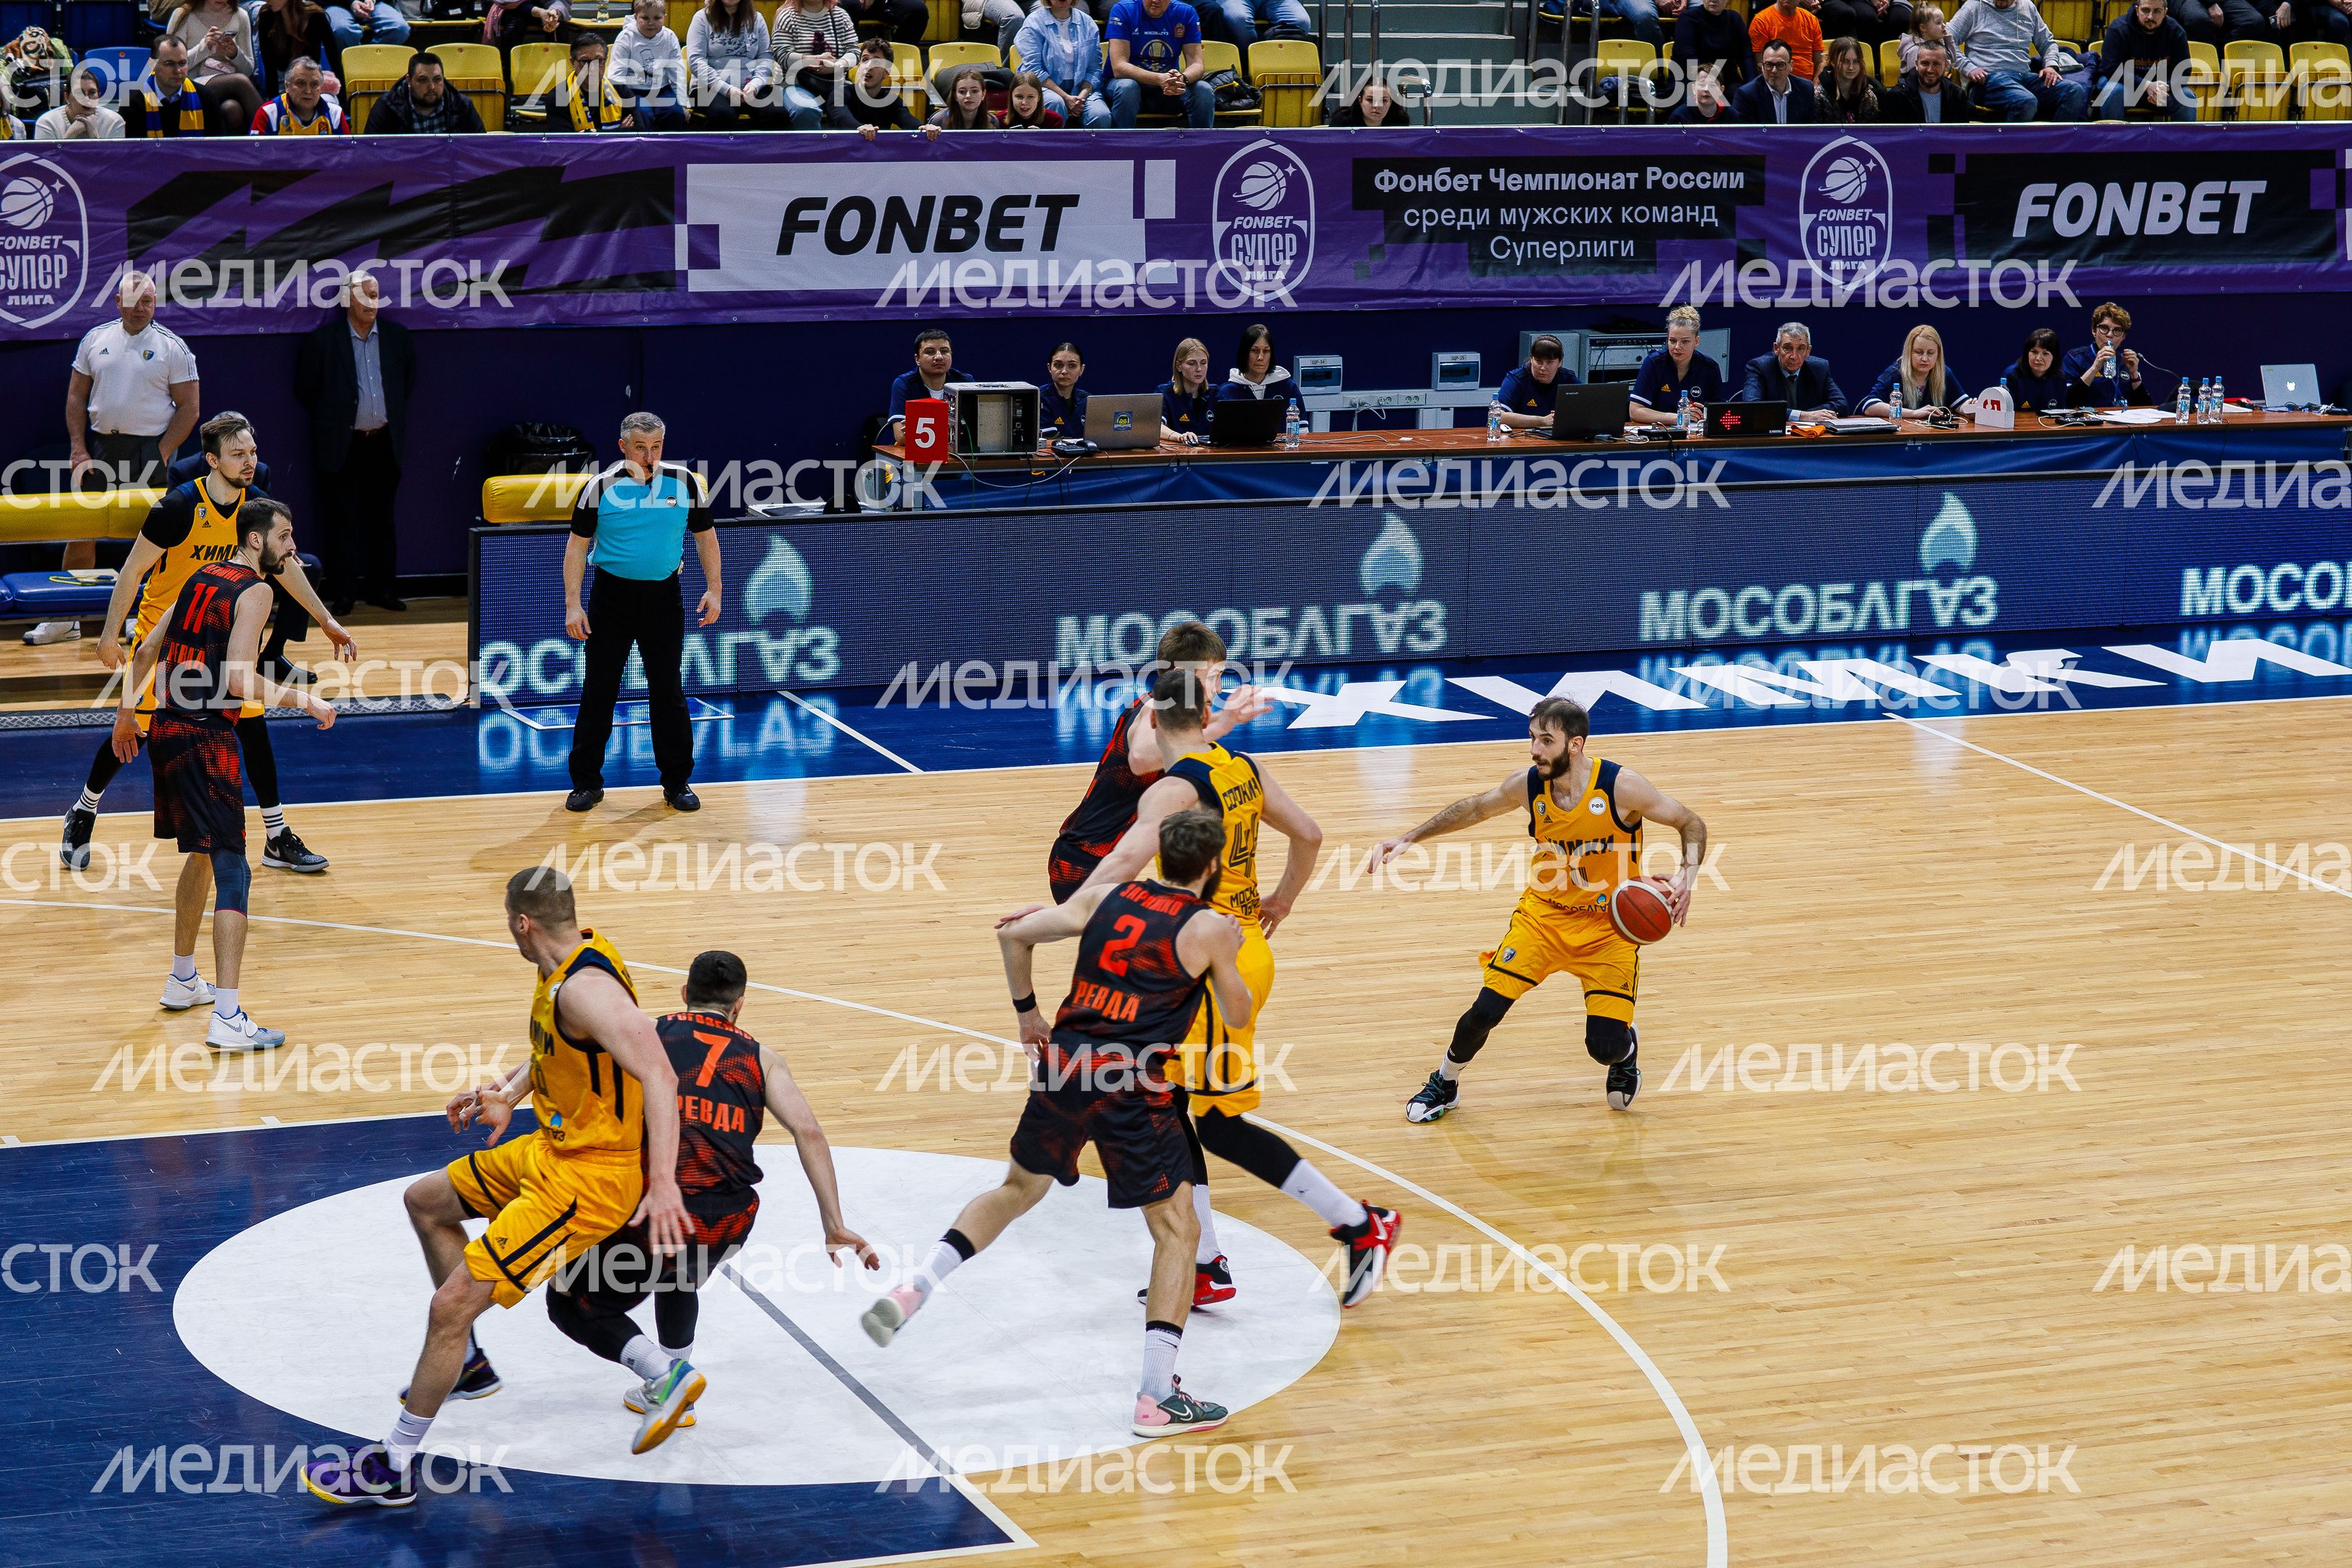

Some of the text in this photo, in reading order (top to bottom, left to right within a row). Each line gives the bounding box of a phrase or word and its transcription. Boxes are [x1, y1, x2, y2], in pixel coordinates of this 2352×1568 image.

[1374, 167, 1744, 192] Фонбет Чемпионат России
[1233, 216, 1294, 229] FONBET
[1404, 204, 1718, 233] среди мужских команд
[1818, 208, 1873, 221] FONBET
[2012, 179, 2267, 238] FONBET
[776, 194, 1079, 256] FONBET
[1490, 235, 1635, 266] Суперлиги
[1830, 261, 1867, 270] ЛИГА
[1244, 270, 1286, 280] ЛИГА
[7, 294, 55, 306] ЛИГА
[914, 417, 936, 449] 5
[189, 544, 238, 561] ХИМ
[2180, 560, 2352, 616] МОСО
[182, 583, 219, 634] 11
[1638, 574, 1998, 642] МОСОБЛГАЗ
[1548, 898, 1609, 913] МОСОБЛГА
[1098, 914, 1147, 977] 2
[693, 1029, 732, 1087] 7
